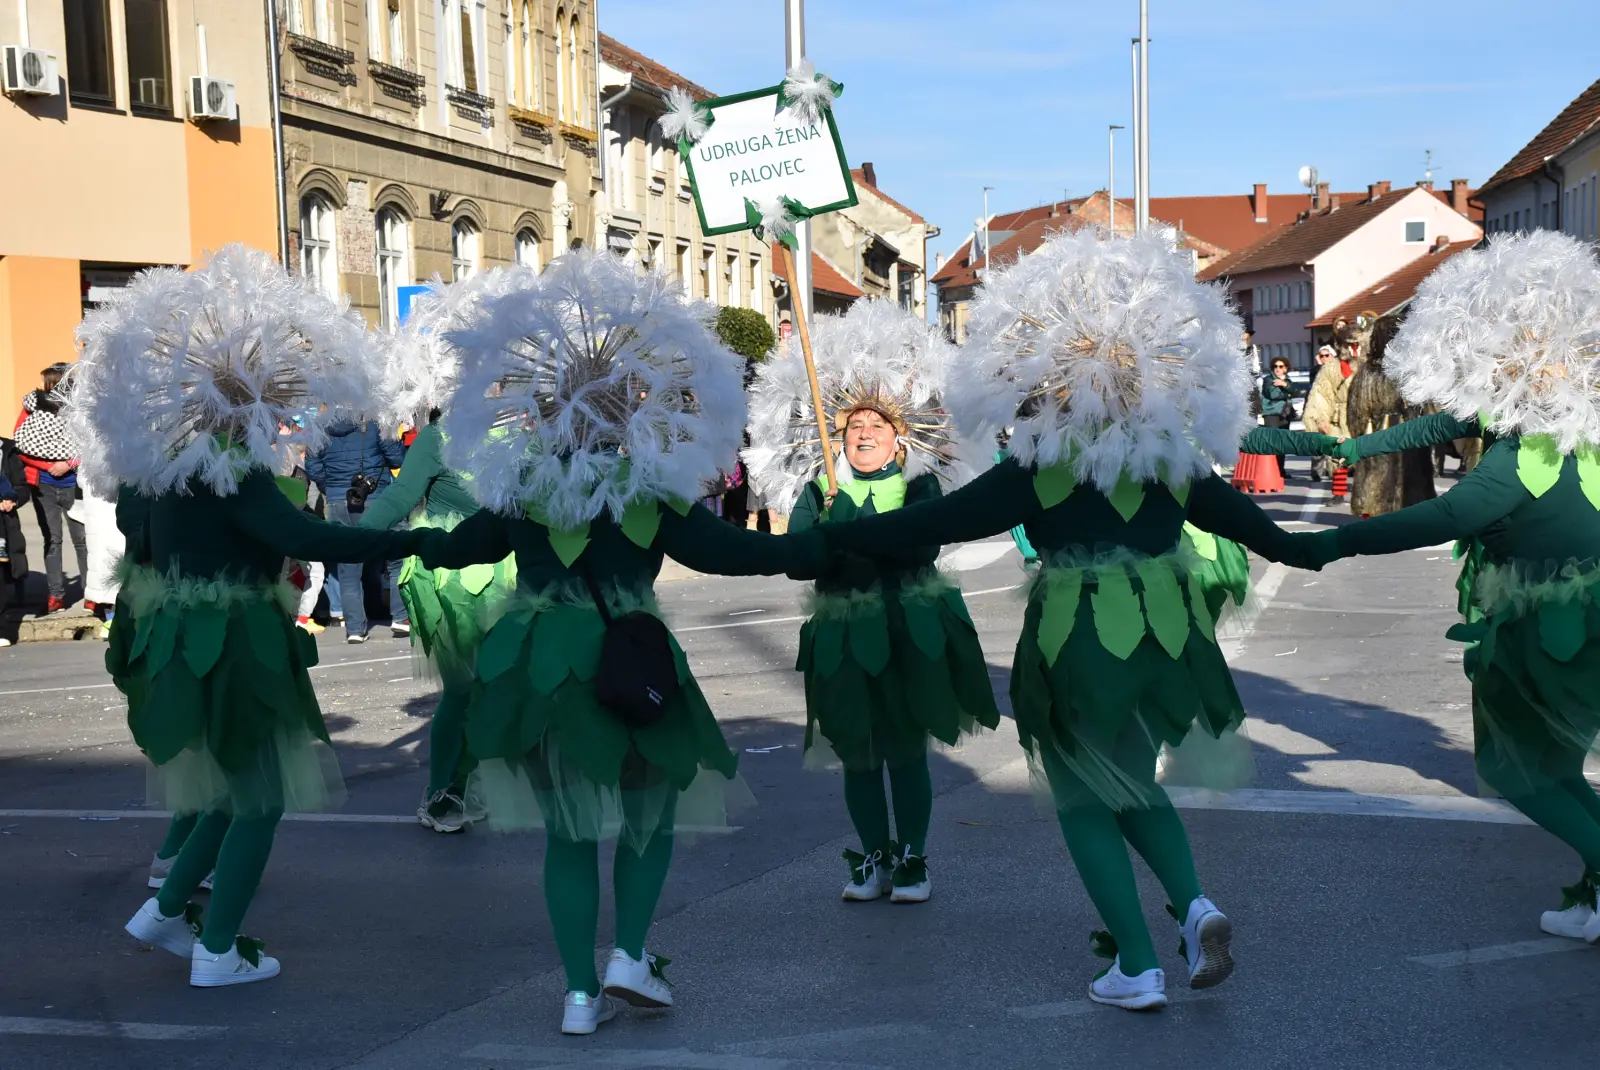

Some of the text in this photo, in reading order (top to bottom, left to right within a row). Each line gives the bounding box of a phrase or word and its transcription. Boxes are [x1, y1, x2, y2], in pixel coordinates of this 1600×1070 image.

[700, 125, 821, 162] UDRUGA ŽENA
[729, 158, 805, 187] PALOVEC
